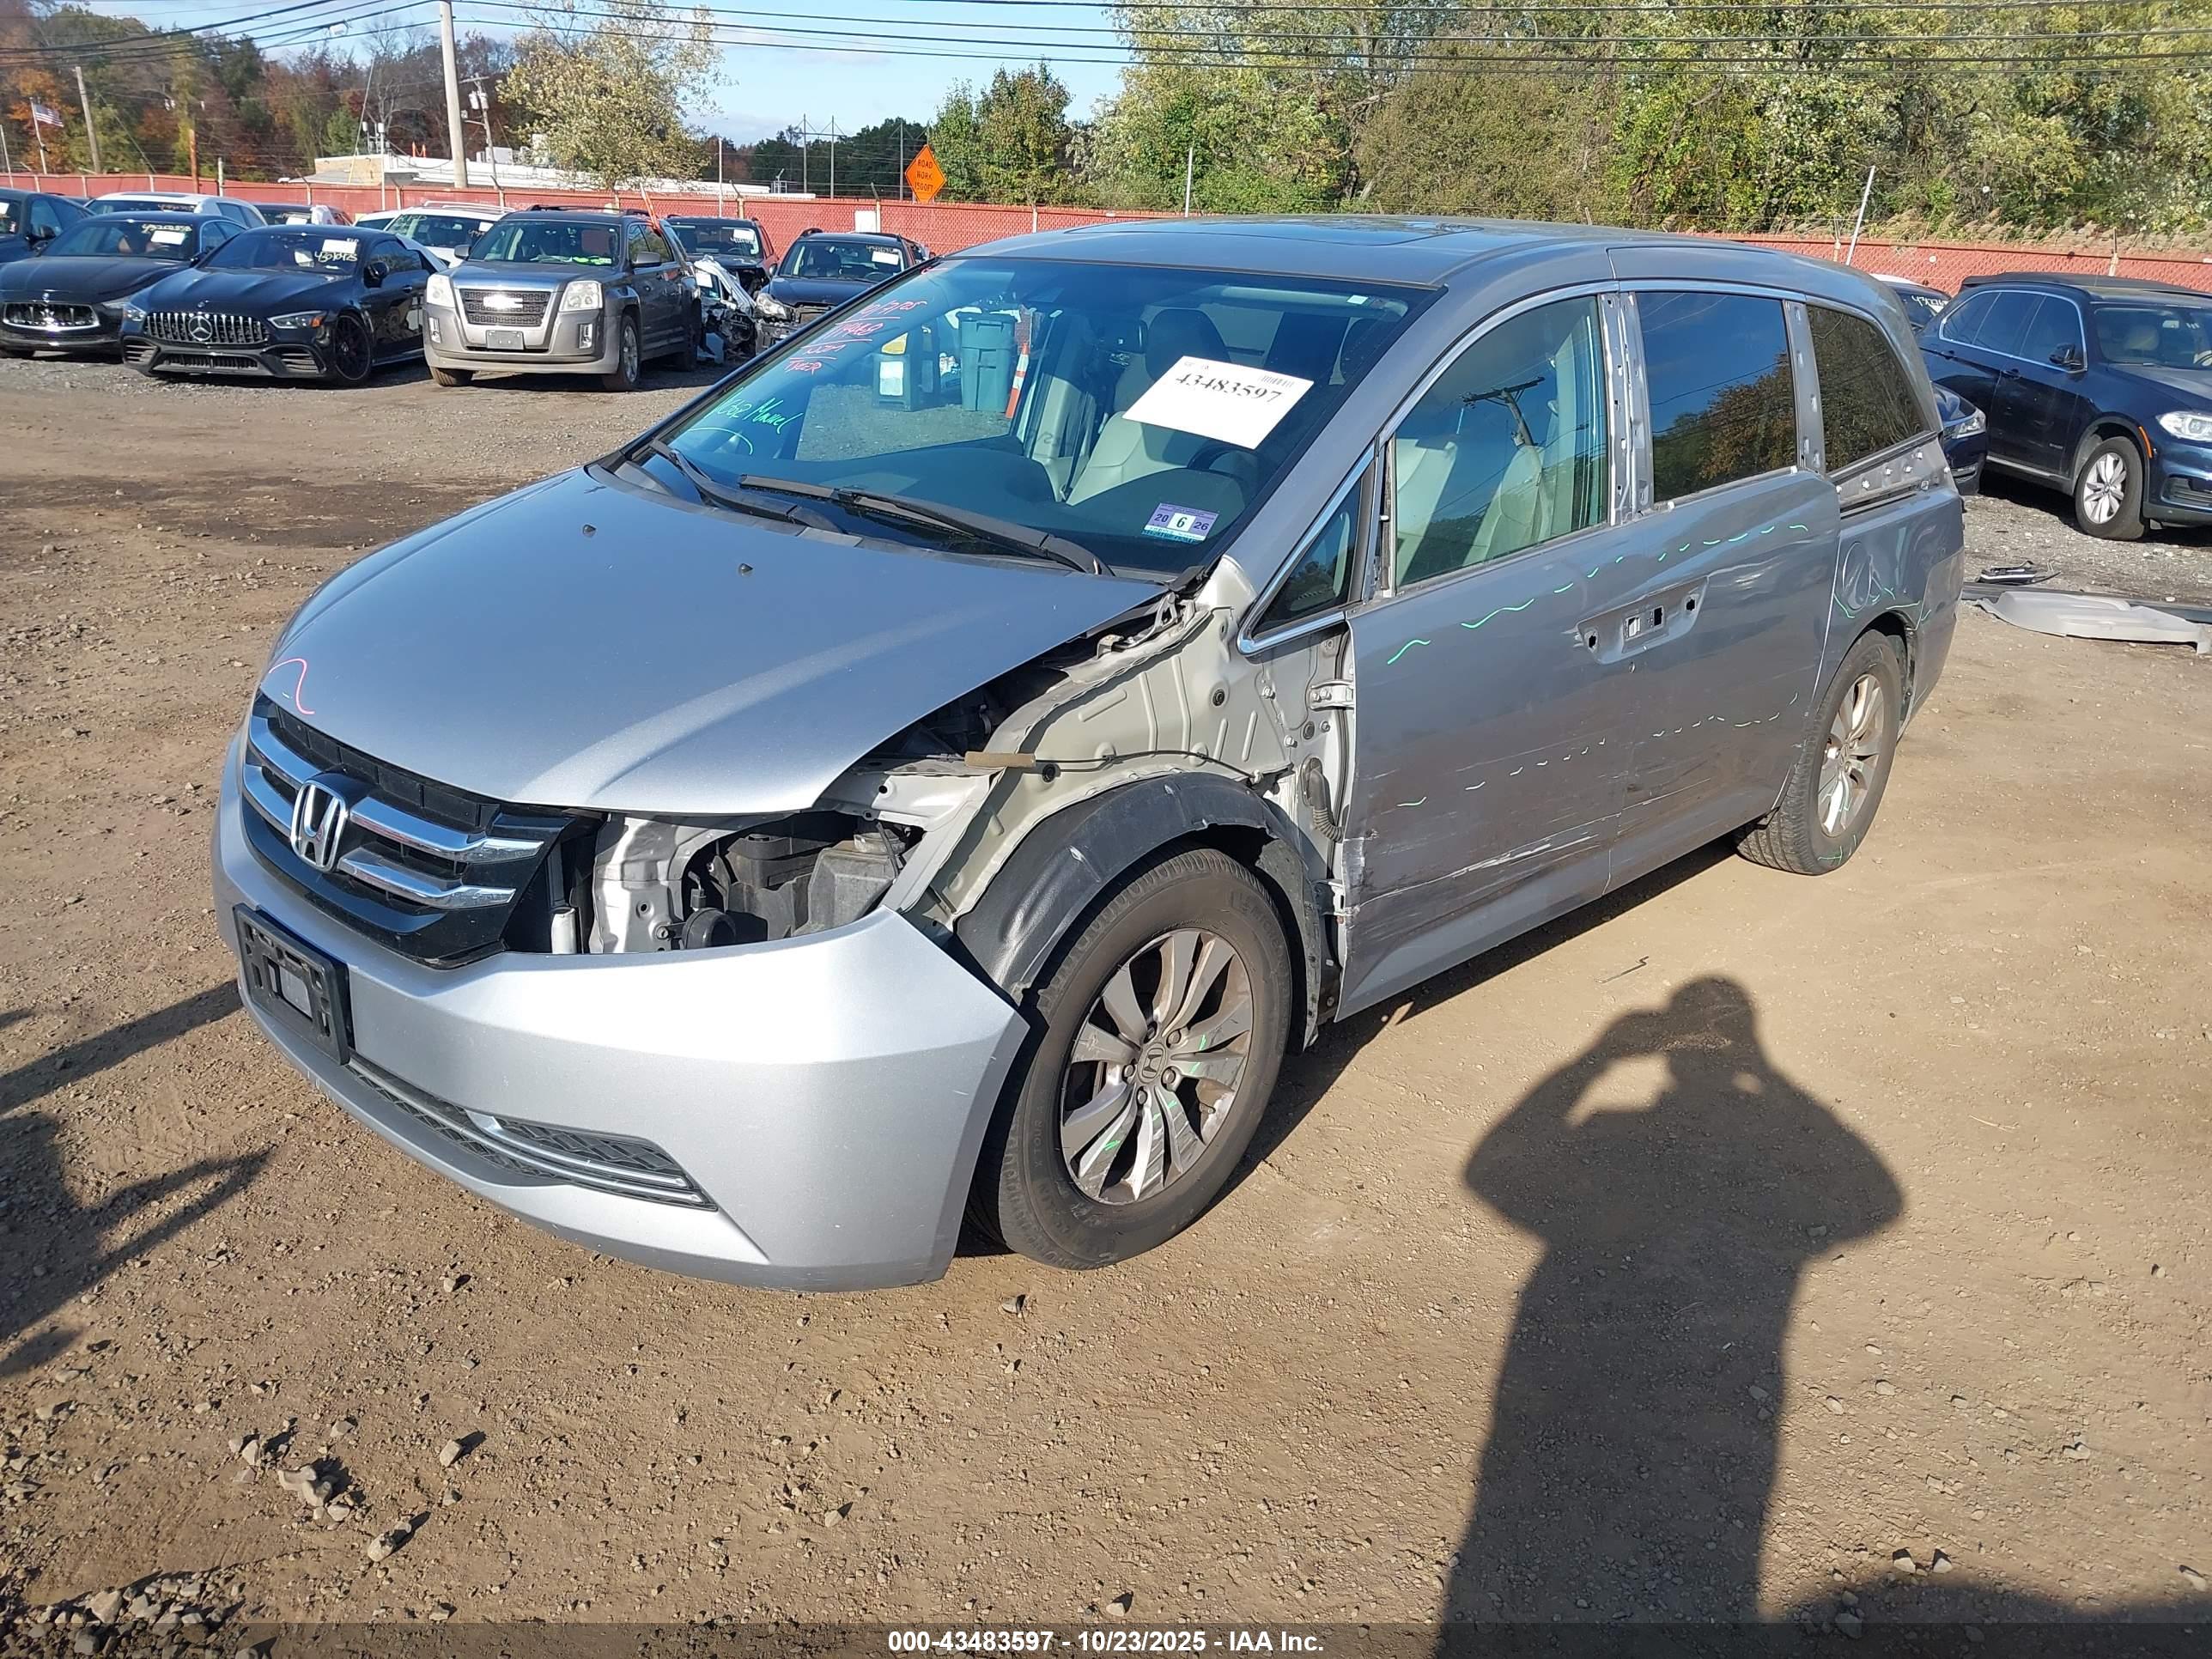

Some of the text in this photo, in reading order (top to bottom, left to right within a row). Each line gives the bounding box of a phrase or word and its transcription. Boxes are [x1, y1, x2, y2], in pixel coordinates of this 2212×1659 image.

[917, 159, 933, 169] ROAD
[916, 171, 933, 180] WORK
[1176, 373, 1282, 403] 43483597
[1153, 514, 1210, 531] 20 6 26
